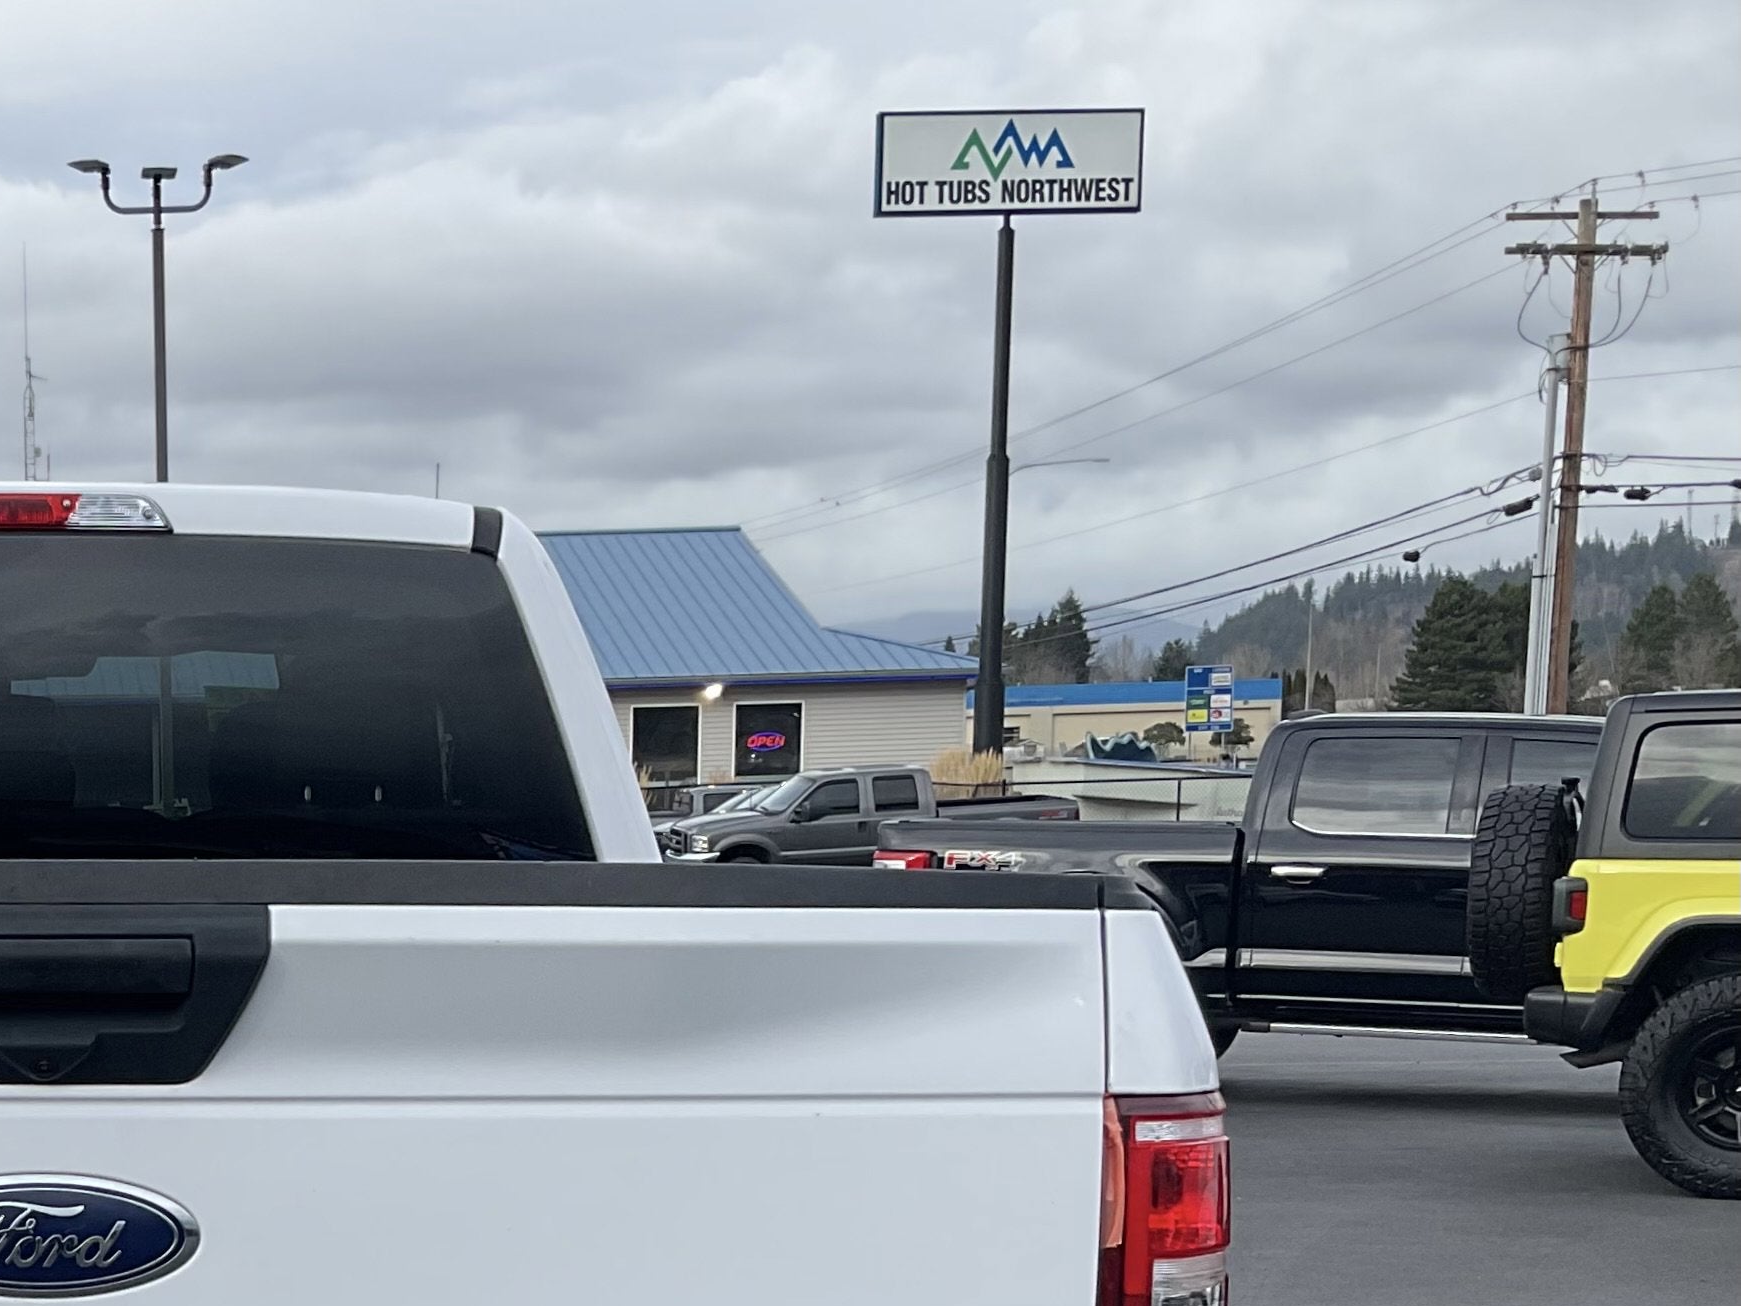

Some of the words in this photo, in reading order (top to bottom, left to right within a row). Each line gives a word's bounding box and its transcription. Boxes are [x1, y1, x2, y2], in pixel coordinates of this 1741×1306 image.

[886, 181, 928, 205] HOT
[935, 180, 991, 204] TUBS
[1001, 177, 1135, 204] NORTHWEST
[747, 735, 786, 748] OPEN
